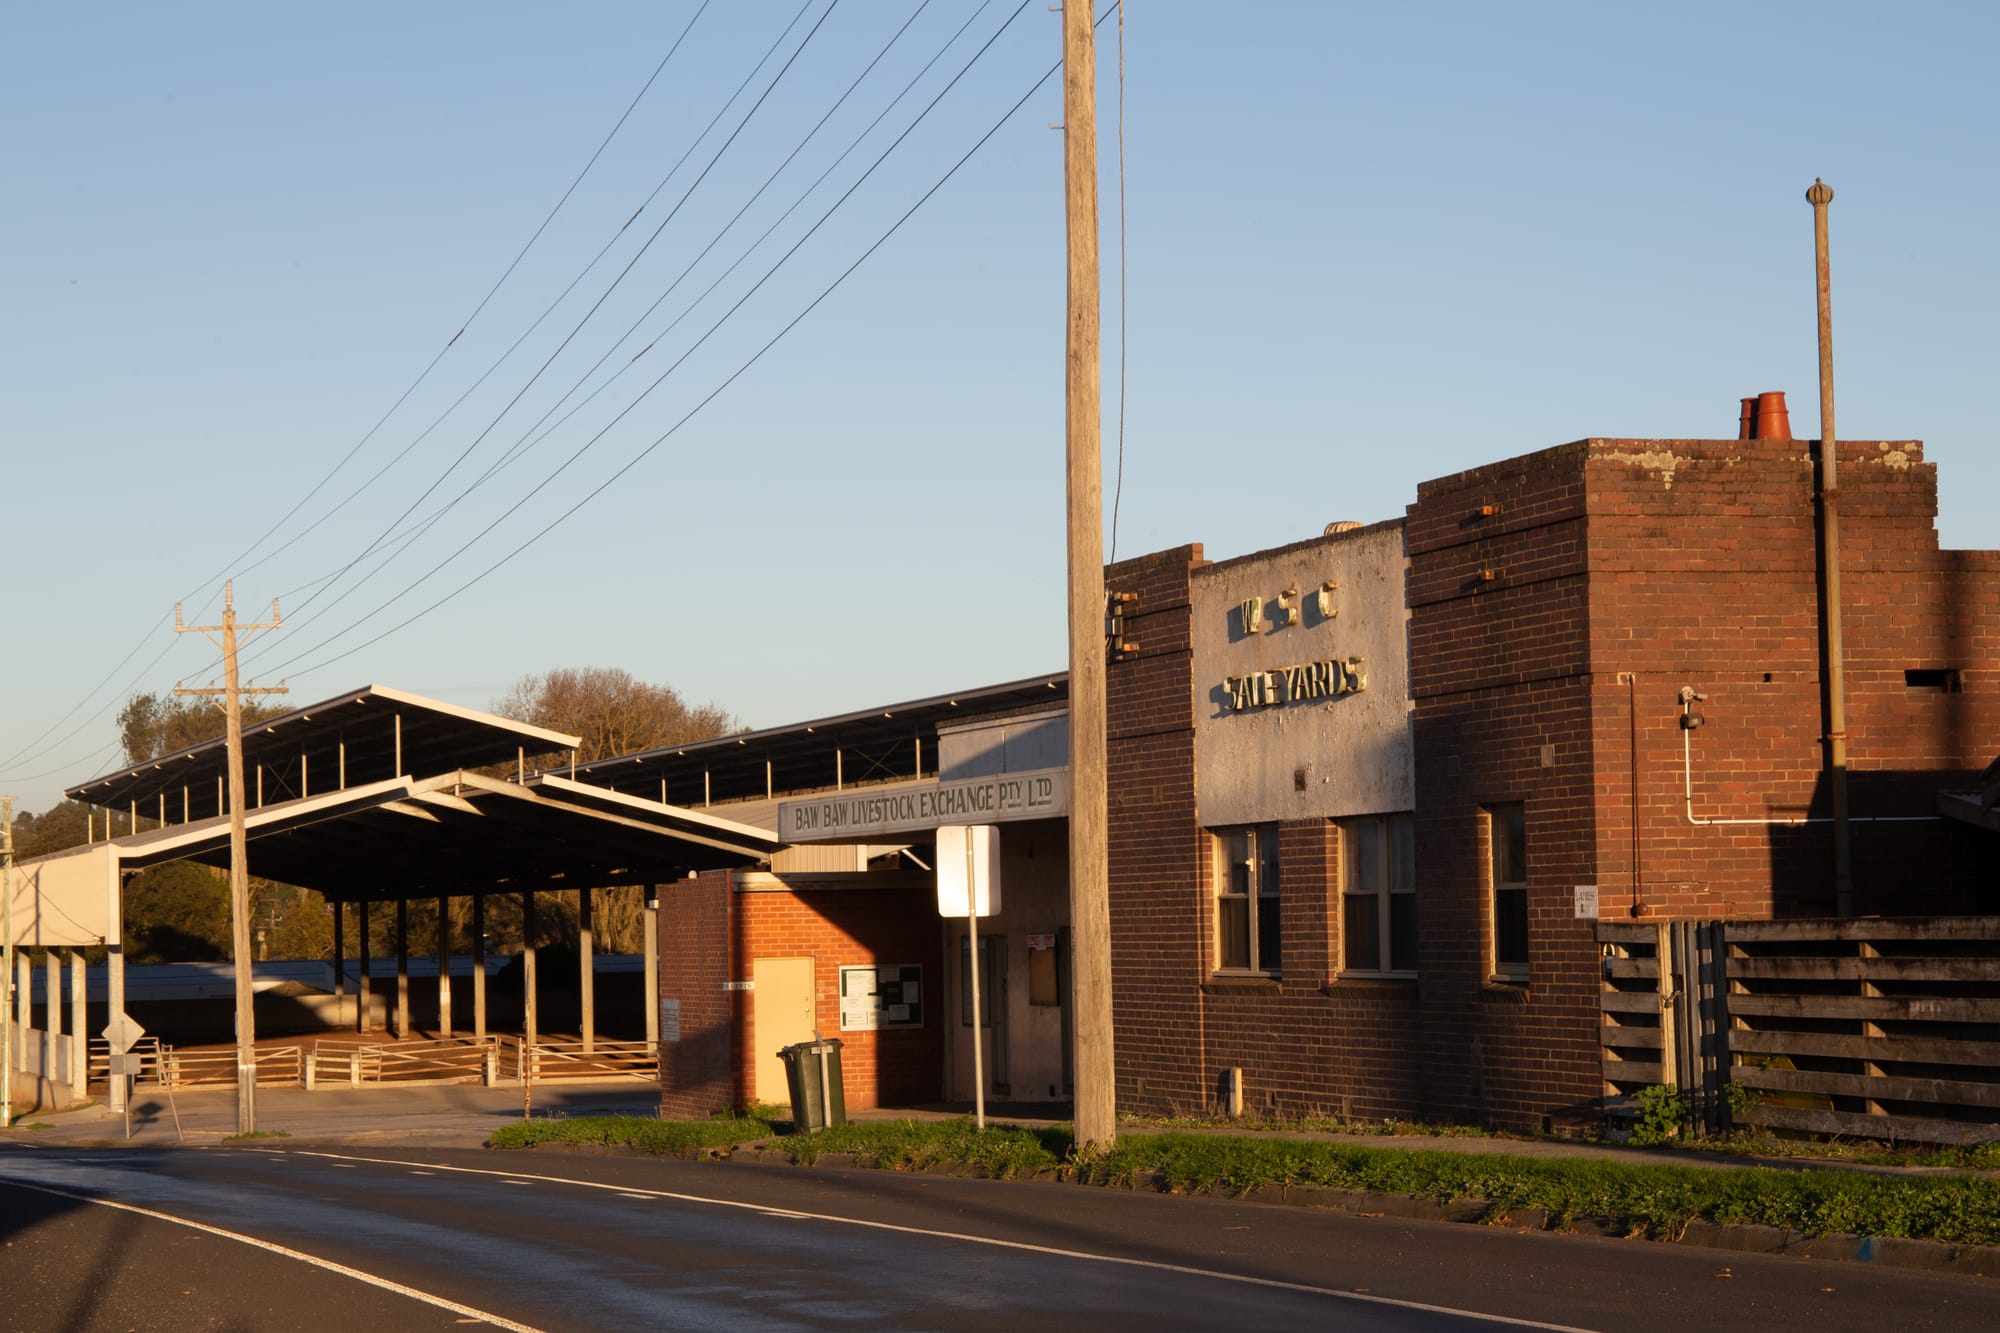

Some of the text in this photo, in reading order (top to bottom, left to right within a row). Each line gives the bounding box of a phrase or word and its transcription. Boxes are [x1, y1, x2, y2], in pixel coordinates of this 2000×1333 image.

[795, 777, 1053, 831] BAW BAW LIVESTOCK EXCHANGE PTY LTD
